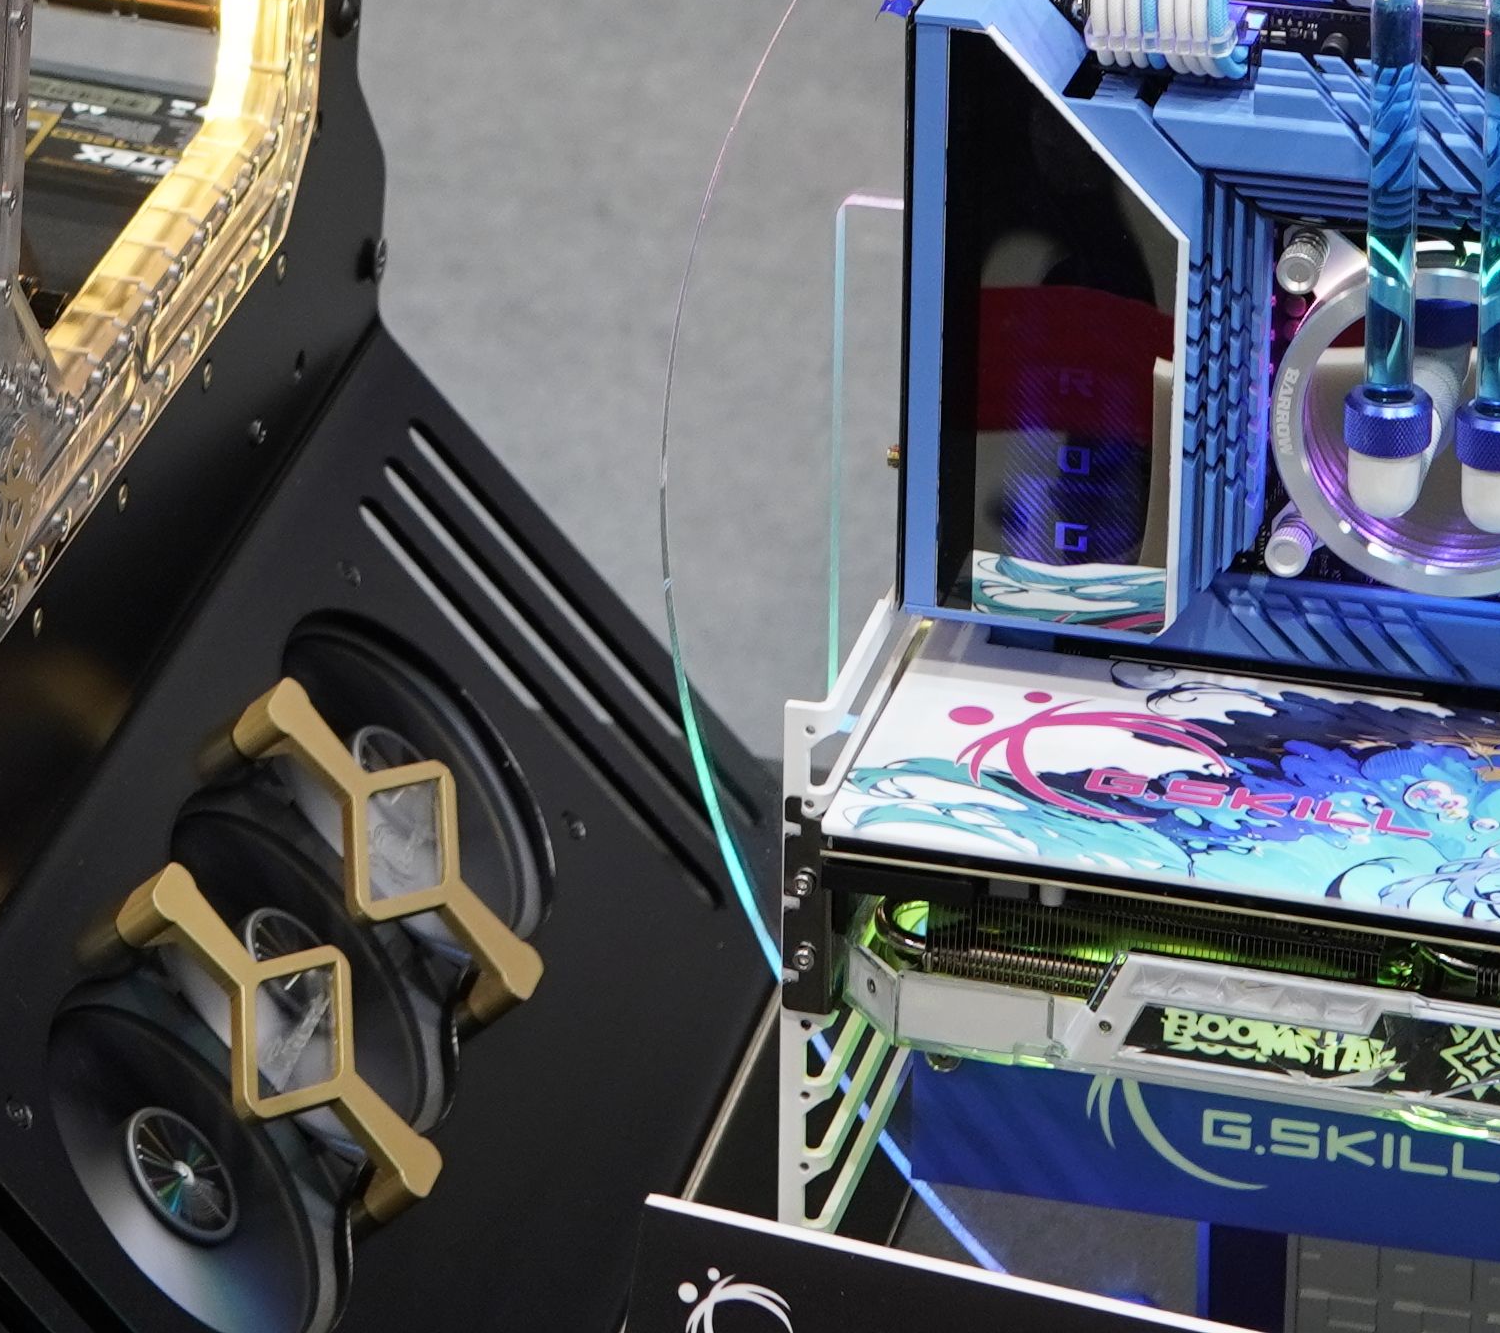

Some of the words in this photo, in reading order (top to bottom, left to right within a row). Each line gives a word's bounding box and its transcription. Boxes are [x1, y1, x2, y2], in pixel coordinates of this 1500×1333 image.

[1276, 367, 1300, 455] BARROW
[1084, 768, 1433, 839] G.SKILL
[1201, 1108, 1500, 1183] G.SKILL
